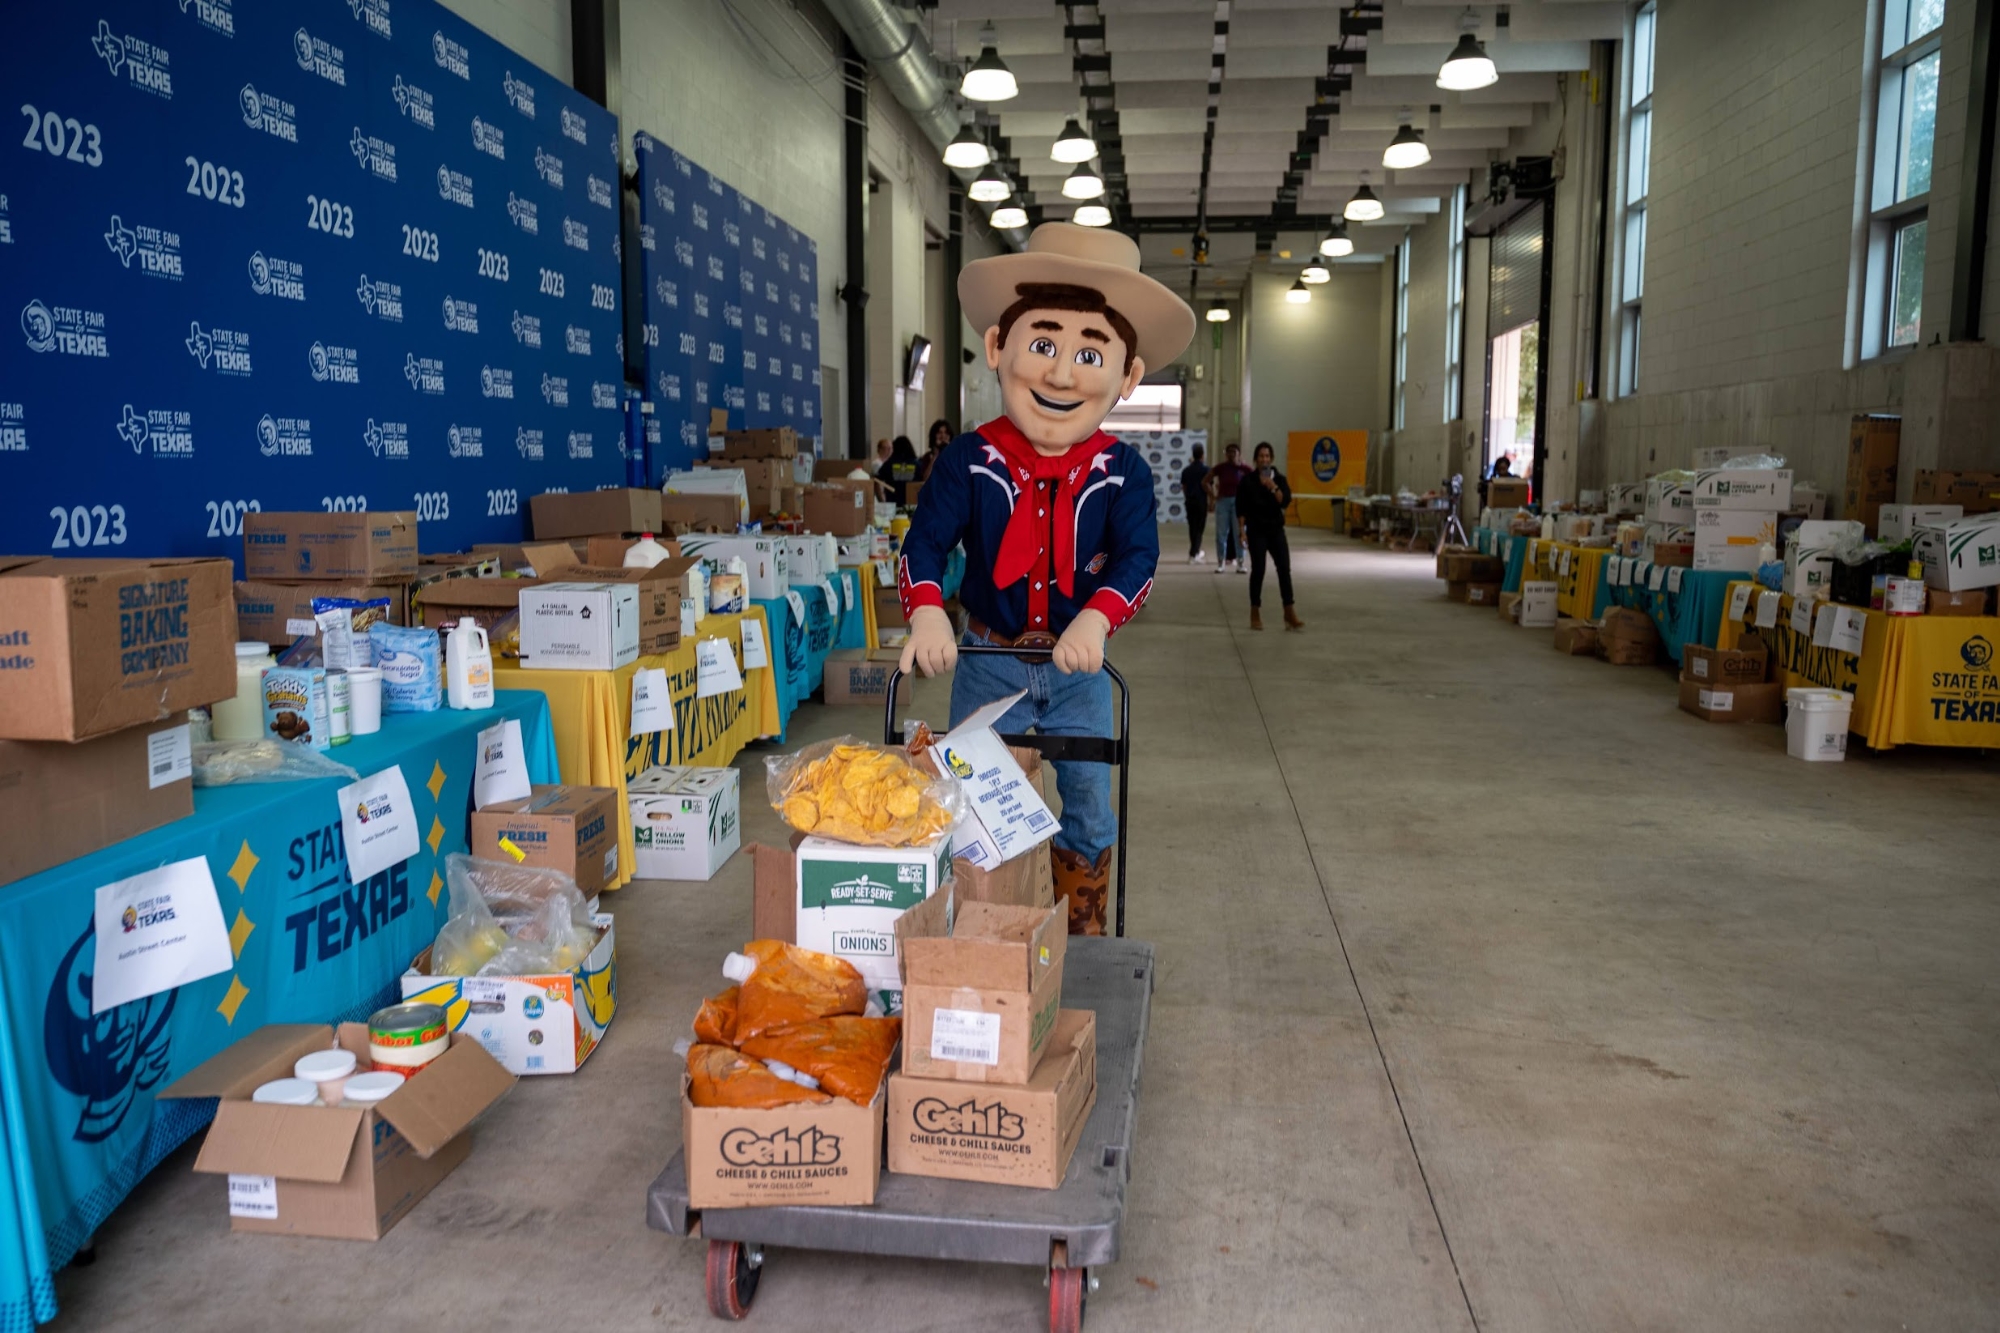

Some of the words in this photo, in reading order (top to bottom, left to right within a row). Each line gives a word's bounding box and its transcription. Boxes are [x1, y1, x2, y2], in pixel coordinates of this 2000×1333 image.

[195, 1, 233, 33] TEXAS
[364, 6, 391, 35] TEXAS
[125, 36, 150, 57] STATE
[152, 46, 169, 65] FAIR
[313, 38, 330, 54] STATE
[330, 45, 343, 61] FAIR
[126, 59, 171, 93] TEXAS
[314, 58, 345, 86] TEXAS
[261, 93, 280, 110] STATE
[281, 102, 295, 118] FAIR
[21, 104, 103, 167] 2023
[262, 115, 296, 142] TEXAS
[371, 156, 396, 178] TEXAS
[186, 156, 245, 208] 2023
[307, 195, 354, 238] 2023
[137, 226, 160, 244] STATE
[163, 233, 180, 248] FAIR
[403, 224, 439, 262] 2023
[138, 249, 182, 275] TEXAS
[269, 258, 288, 273] STATE
[289, 263, 302, 275] FAIR
[478, 248, 508, 280] 2023
[271, 276, 304, 300] TEXAS
[540, 268, 564, 298] 2023
[377, 299, 402, 317] TEXAS
[592, 284, 614, 311] 2023
[53, 307, 82, 324] STATE
[85, 311, 104, 327] FAIR
[55, 332, 106, 356] TEXAS
[213, 329, 233, 343] STATE
[235, 333, 249, 346] FAIR
[680, 333, 695, 356] 2023
[214, 349, 251, 371] TEXAS
[328, 347, 343, 359] STATE
[344, 349, 357, 360] FAIR
[709, 342, 724, 363] 2023
[744, 350, 756, 369] 2023
[329, 365, 358, 383] TEXAS
[769, 357, 781, 376] 2023
[421, 374, 444, 390] TEXAS
[149, 410, 171, 425] STATE
[175, 412, 190, 425] FAIR
[277, 418, 295, 430] STATE
[297, 420, 310, 431] FAIR
[150, 433, 193, 453] TEXAS
[279, 438, 311, 455] TEXAS
[384, 439, 408, 455] TEXAS
[414, 492, 449, 521] 2023
[487, 489, 517, 516] 2023
[50, 504, 127, 548] 2023
[248, 534, 286, 544] FRESH
[119, 578, 189, 610] SIGNATURE
[238, 604, 274, 614] FRESH
[120, 603, 188, 649] BAKING
[121, 642, 189, 675] COMPANY
[381, 664, 420, 672] Granulated
[849, 667, 886, 677] SIGNATURE
[850, 676, 886, 686] BAKING
[1932, 672, 1978, 689] STATE
[266, 679, 307, 696] Teddy
[850, 686, 885, 694] COMPANY
[370, 804, 391, 819] TEXAS
[498, 831, 548, 842] FRESH
[577, 816, 605, 845] FRESH
[138, 907, 175, 929] TEXAS
[286, 858, 408, 973] TEXAS
[840, 937, 887, 951] ONIONS
[913, 1097, 1024, 1141] Gehl's
[720, 1124, 841, 1166] Gehl's
[910, 1133, 948, 1146] CHEESE
[951, 1138, 956, 1146] &
[959, 1139, 988, 1150] CHILI
[991, 1141, 1031, 1154] SAUCES
[716, 1168, 757, 1179] CHEESE
[761, 1170, 767, 1178] &
[770, 1169, 801, 1179] CHILI
[805, 1166, 848, 1178] SAUCES
